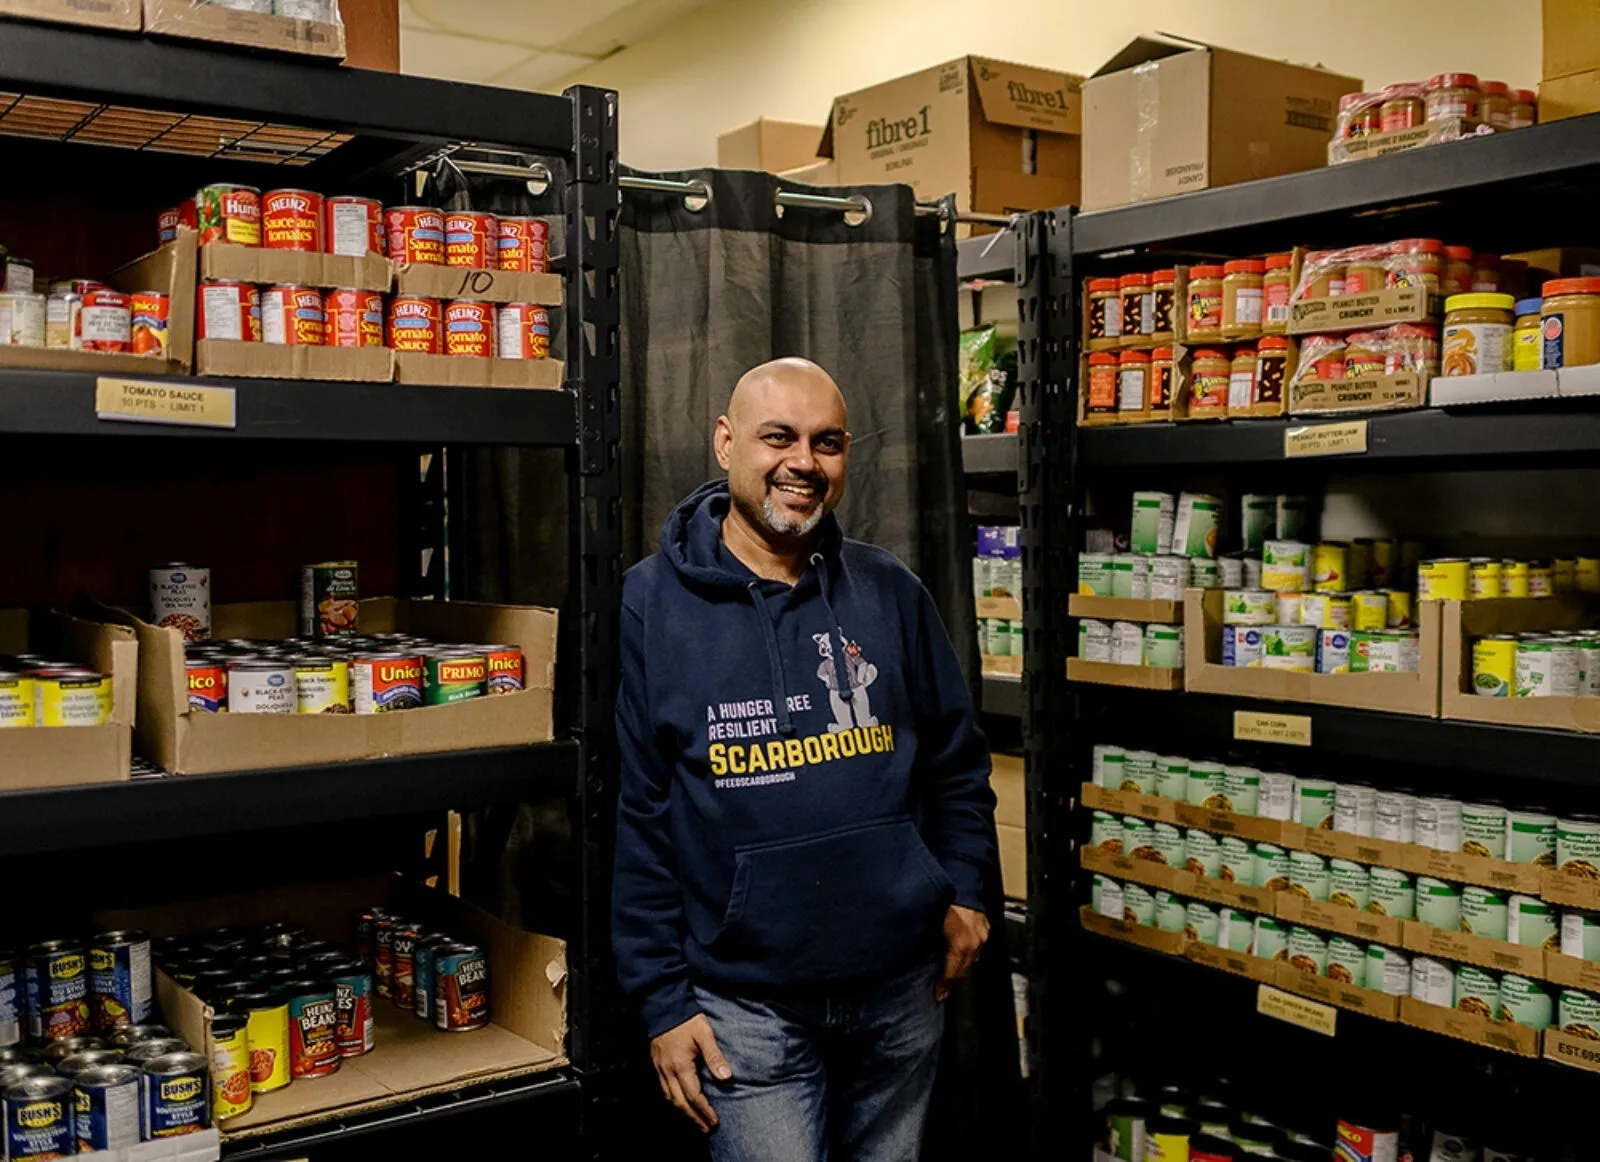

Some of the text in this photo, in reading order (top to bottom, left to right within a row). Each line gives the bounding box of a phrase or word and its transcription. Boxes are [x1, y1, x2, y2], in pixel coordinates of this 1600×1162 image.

[1006, 80, 1070, 110] fibre1
[865, 105, 932, 149] fibre1
[271, 198, 305, 213] HEINZ
[263, 217, 294, 229] Sauce
[447, 218, 473, 231] EINZ
[268, 228, 312, 242] tomates
[448, 254, 474, 265] auce
[457, 271, 494, 295] 10
[396, 303, 428, 317] HEINZ
[449, 307, 481, 321] HEINZ
[1338, 308, 1374, 319] CRUNCHY
[392, 327, 434, 340] Tomato
[446, 331, 487, 343] Tomato
[395, 339, 430, 351] Sauce
[450, 342, 482, 354] Sauce
[122, 385, 204, 402] TOMATO SAUCE
[1337, 391, 1372, 402] CRUNCHY
[136, 399, 157, 410] PTS
[170, 403, 196, 413] LIMIT
[442, 665, 484, 680] PRIMO
[190, 674, 215, 689] ico
[707, 694, 812, 722] A HUNGER REE
[708, 718, 778, 741] RESILIENT
[708, 724, 895, 776] SCARBOROUGH
[51, 957, 85, 974] BUSH'S
[306, 1002, 334, 1018] HEINZ
[302, 1011, 336, 1030] BEANS
[163, 1080, 201, 1095] BUSH'S
[20, 1103, 61, 1123] BUSH'S
